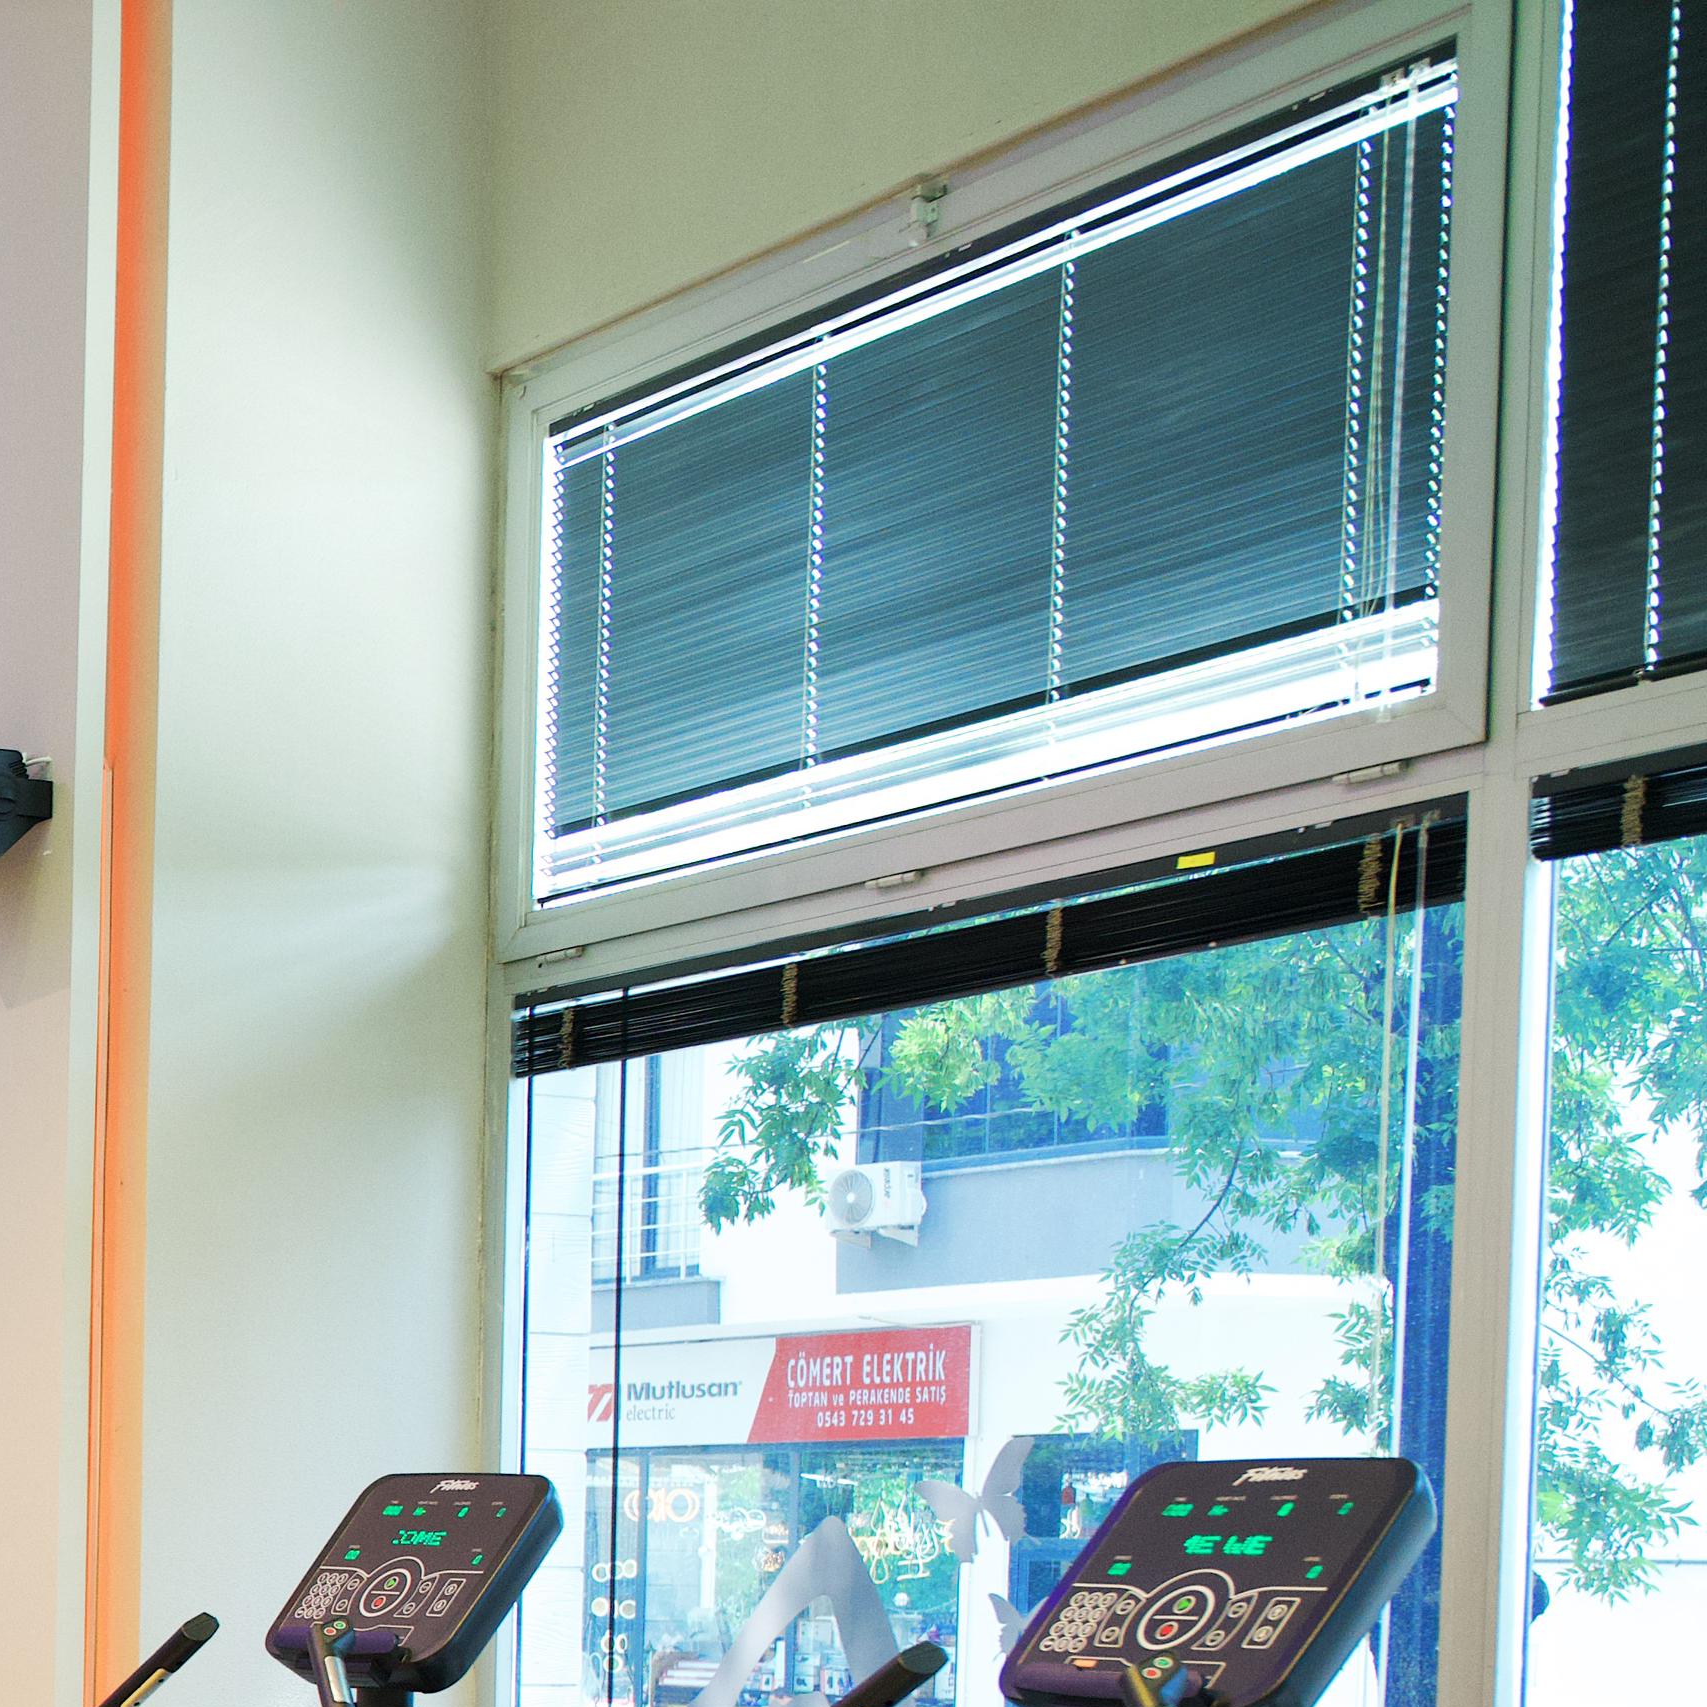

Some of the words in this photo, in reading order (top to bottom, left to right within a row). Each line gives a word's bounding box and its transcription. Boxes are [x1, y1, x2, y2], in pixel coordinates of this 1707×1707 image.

[786, 1351, 853, 1389] CÖMERT
[862, 1343, 947, 1384] ELEKTRİK
[626, 1380, 740, 1401] Mutlusan
[787, 1389, 828, 1409] TOPTAN
[832, 1392, 845, 1407] ve
[849, 1388, 911, 1407] PERAKENDE
[915, 1385, 947, 1405] SATIŞ
[626, 1404, 676, 1422] electric
[816, 1410, 846, 1428] 0543
[851, 1409, 875, 1427] 729
[878, 1409, 893, 1426] 31
[899, 1408, 915, 1425] 45
